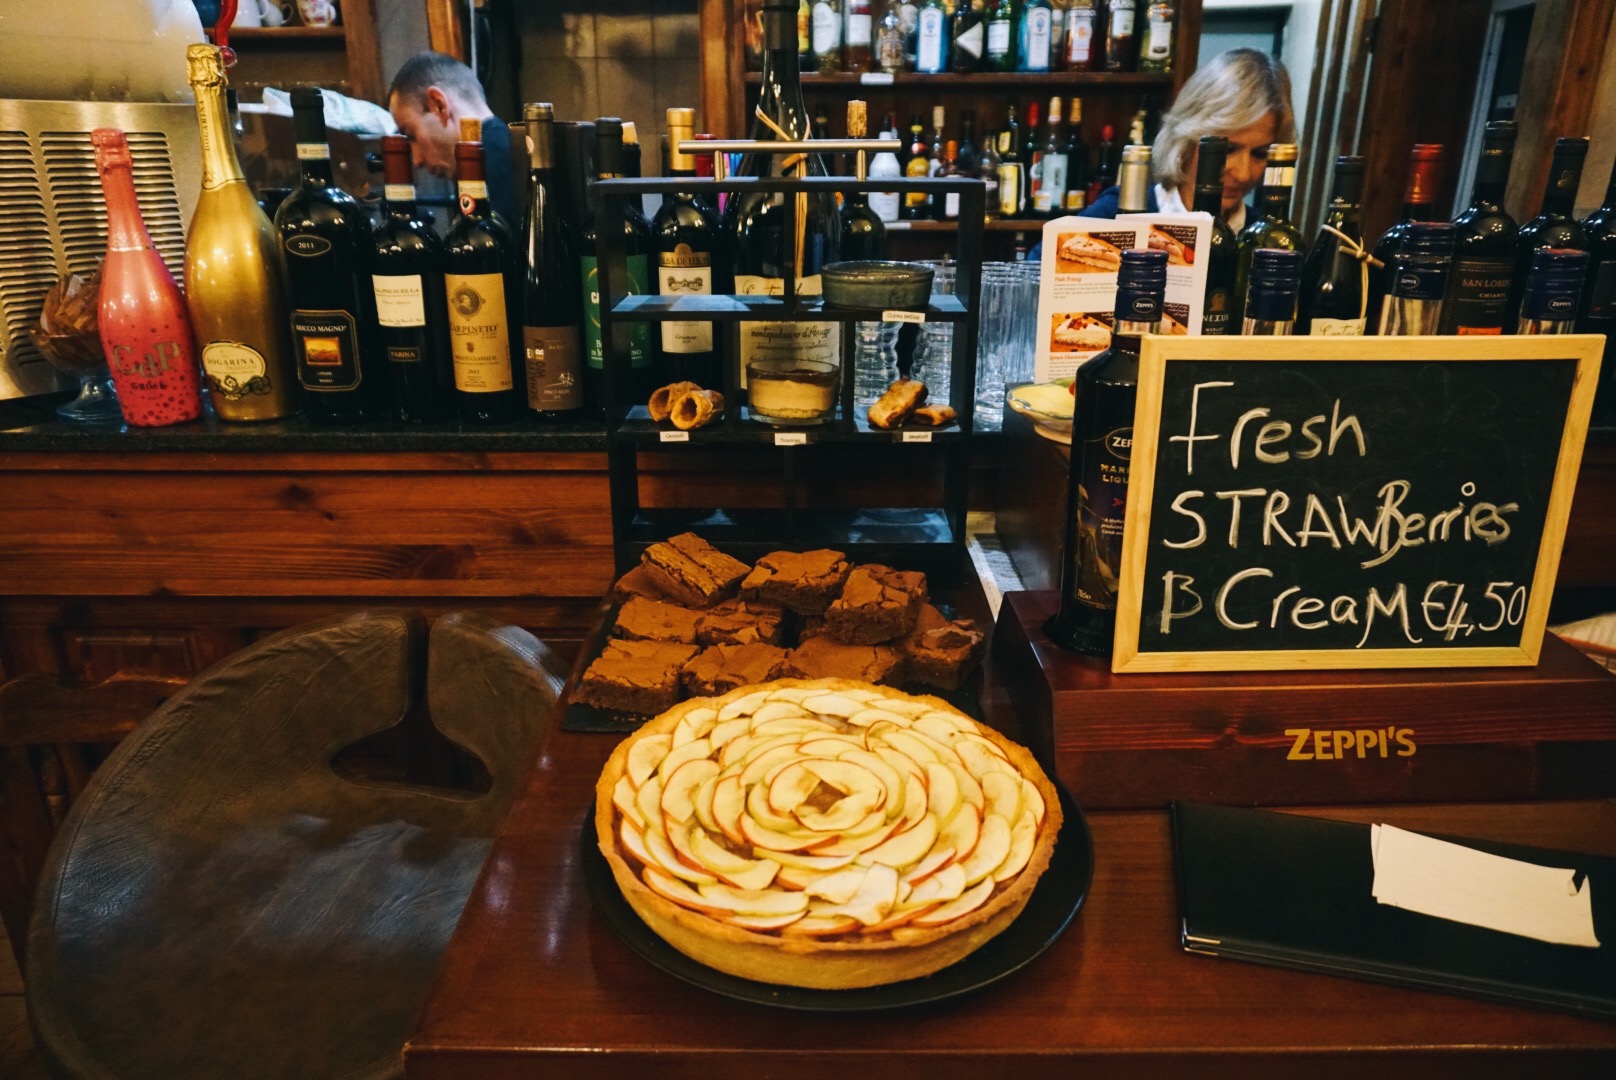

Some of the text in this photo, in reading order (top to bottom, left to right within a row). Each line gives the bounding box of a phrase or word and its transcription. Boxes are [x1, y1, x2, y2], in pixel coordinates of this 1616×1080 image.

[1462, 278, 1483, 287] SAN
[1169, 381, 1366, 475] Fresh
[1284, 725, 1417, 761] ZEPPI'S
